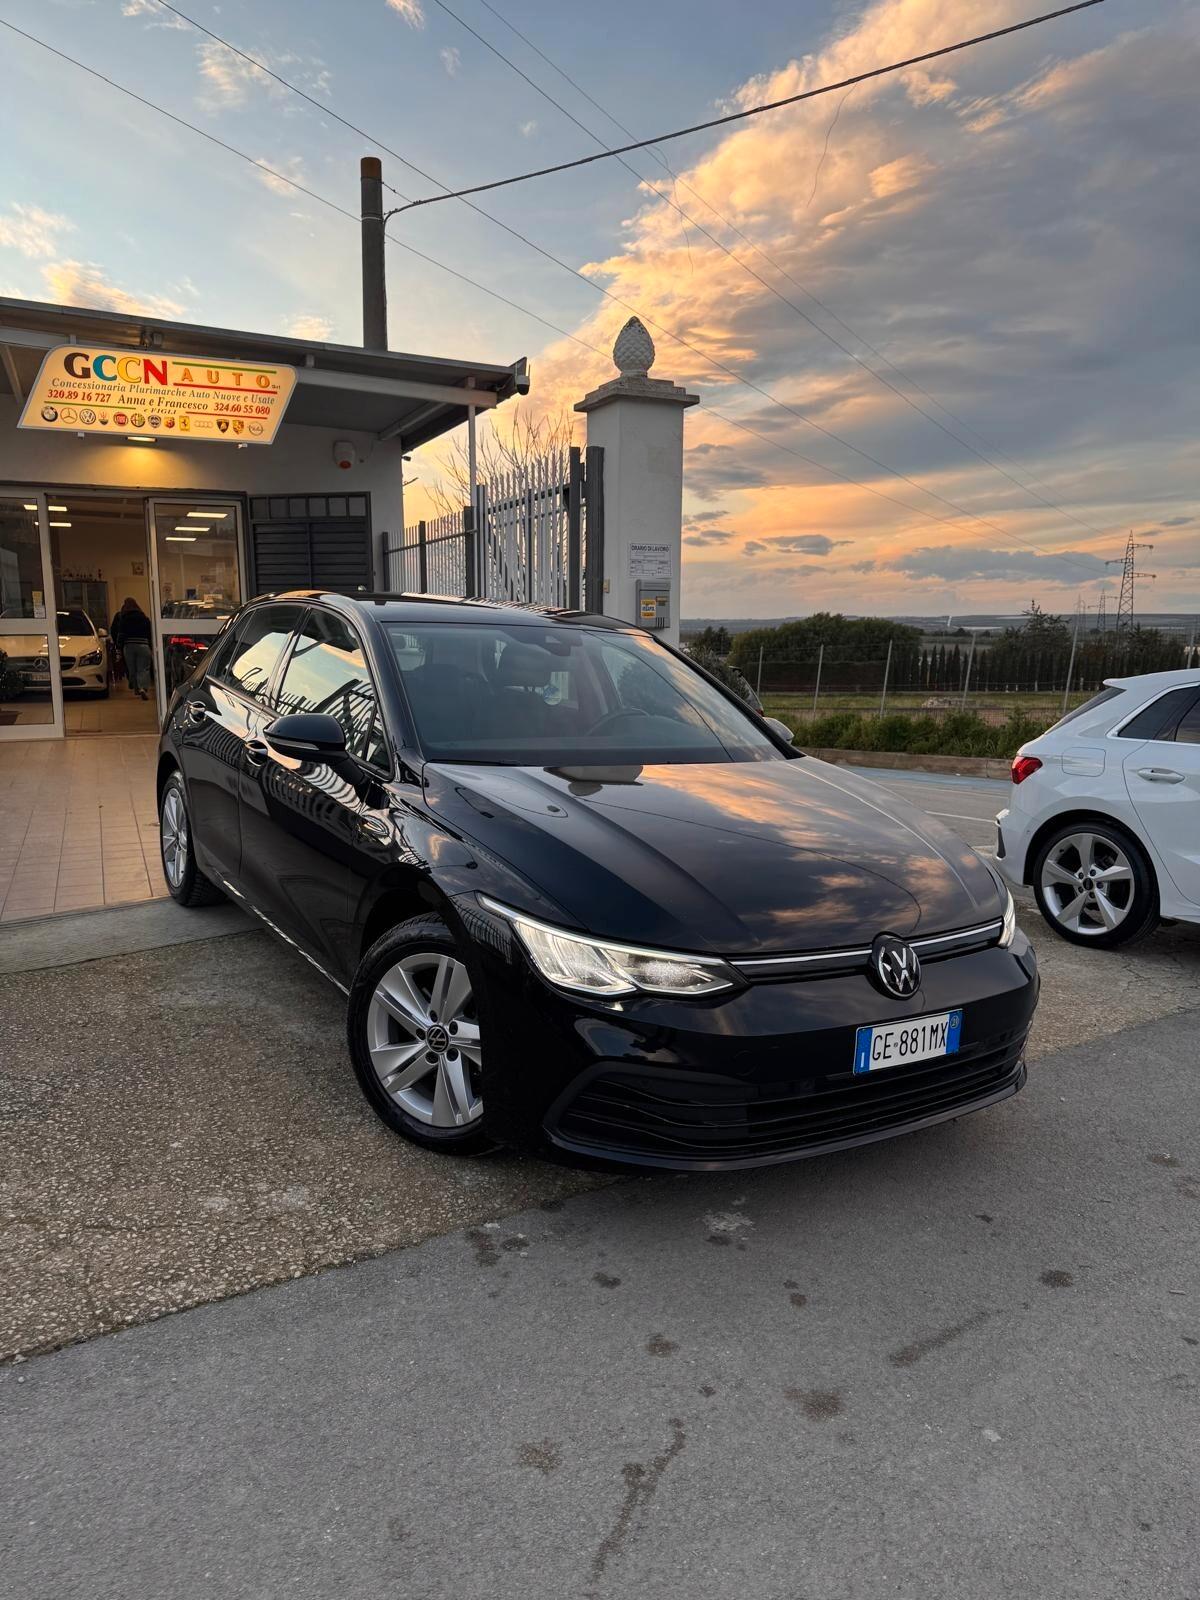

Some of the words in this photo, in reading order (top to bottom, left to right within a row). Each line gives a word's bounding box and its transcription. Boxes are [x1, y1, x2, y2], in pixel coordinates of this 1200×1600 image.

[63, 352, 168, 385] GCCN
[181, 367, 271, 388] AUTO
[48, 389, 79, 400] 320.89
[82, 392, 92, 402] 16
[95, 393, 112, 403] 727
[52, 378, 126, 393] Concessionaria
[129, 384, 187, 397] Plurimarche
[188, 389, 211, 399] Auto
[212, 391, 241, 402] Nuove
[251, 395, 275, 405] Usate
[117, 394, 145, 406] Anna
[157, 396, 209, 410] Francesco
[214, 402, 242, 413] 324.60
[243, 404, 254, 414] 55
[255, 405, 270, 415] 080
